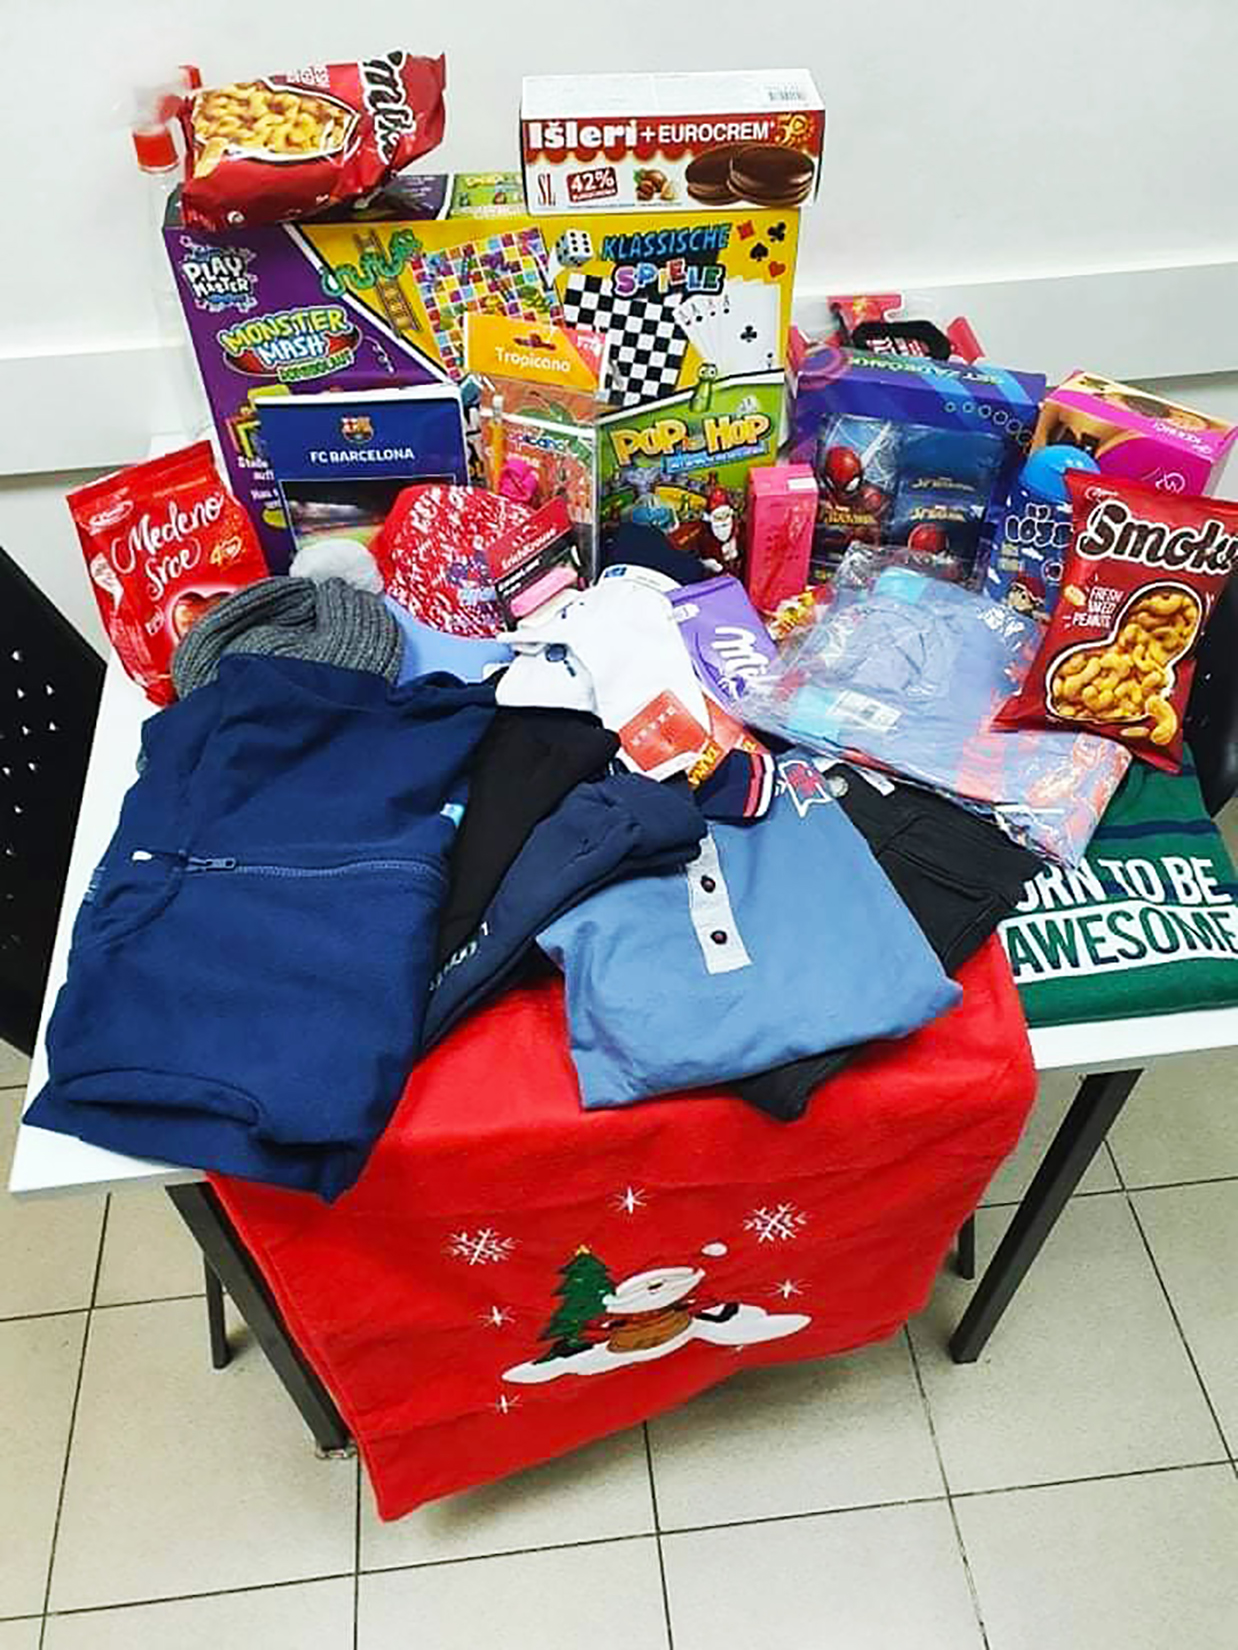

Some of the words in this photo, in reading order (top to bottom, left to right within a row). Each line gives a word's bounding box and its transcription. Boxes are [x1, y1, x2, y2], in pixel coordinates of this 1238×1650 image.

[528, 119, 638, 149] Išleri
[571, 171, 615, 194] 42%
[602, 223, 731, 261] KLASSISCHE
[182, 256, 243, 283] PLAY
[612, 257, 724, 296] SPIELE
[193, 277, 250, 297] MASTER
[219, 308, 347, 353] MONSTER
[256, 334, 326, 365] MASH
[495, 346, 571, 373] Tropicana
[610, 419, 688, 466] POP
[703, 413, 771, 453] HOP
[309, 450, 329, 463] FC
[331, 448, 415, 463] BARCELONA
[111, 491, 225, 573] Medeno
[1090, 586, 1124, 602] FRESH
[1098, 858, 1166, 904] TO
[1160, 856, 1232, 905] BE
[1006, 906, 1238, 977] AWESOME
